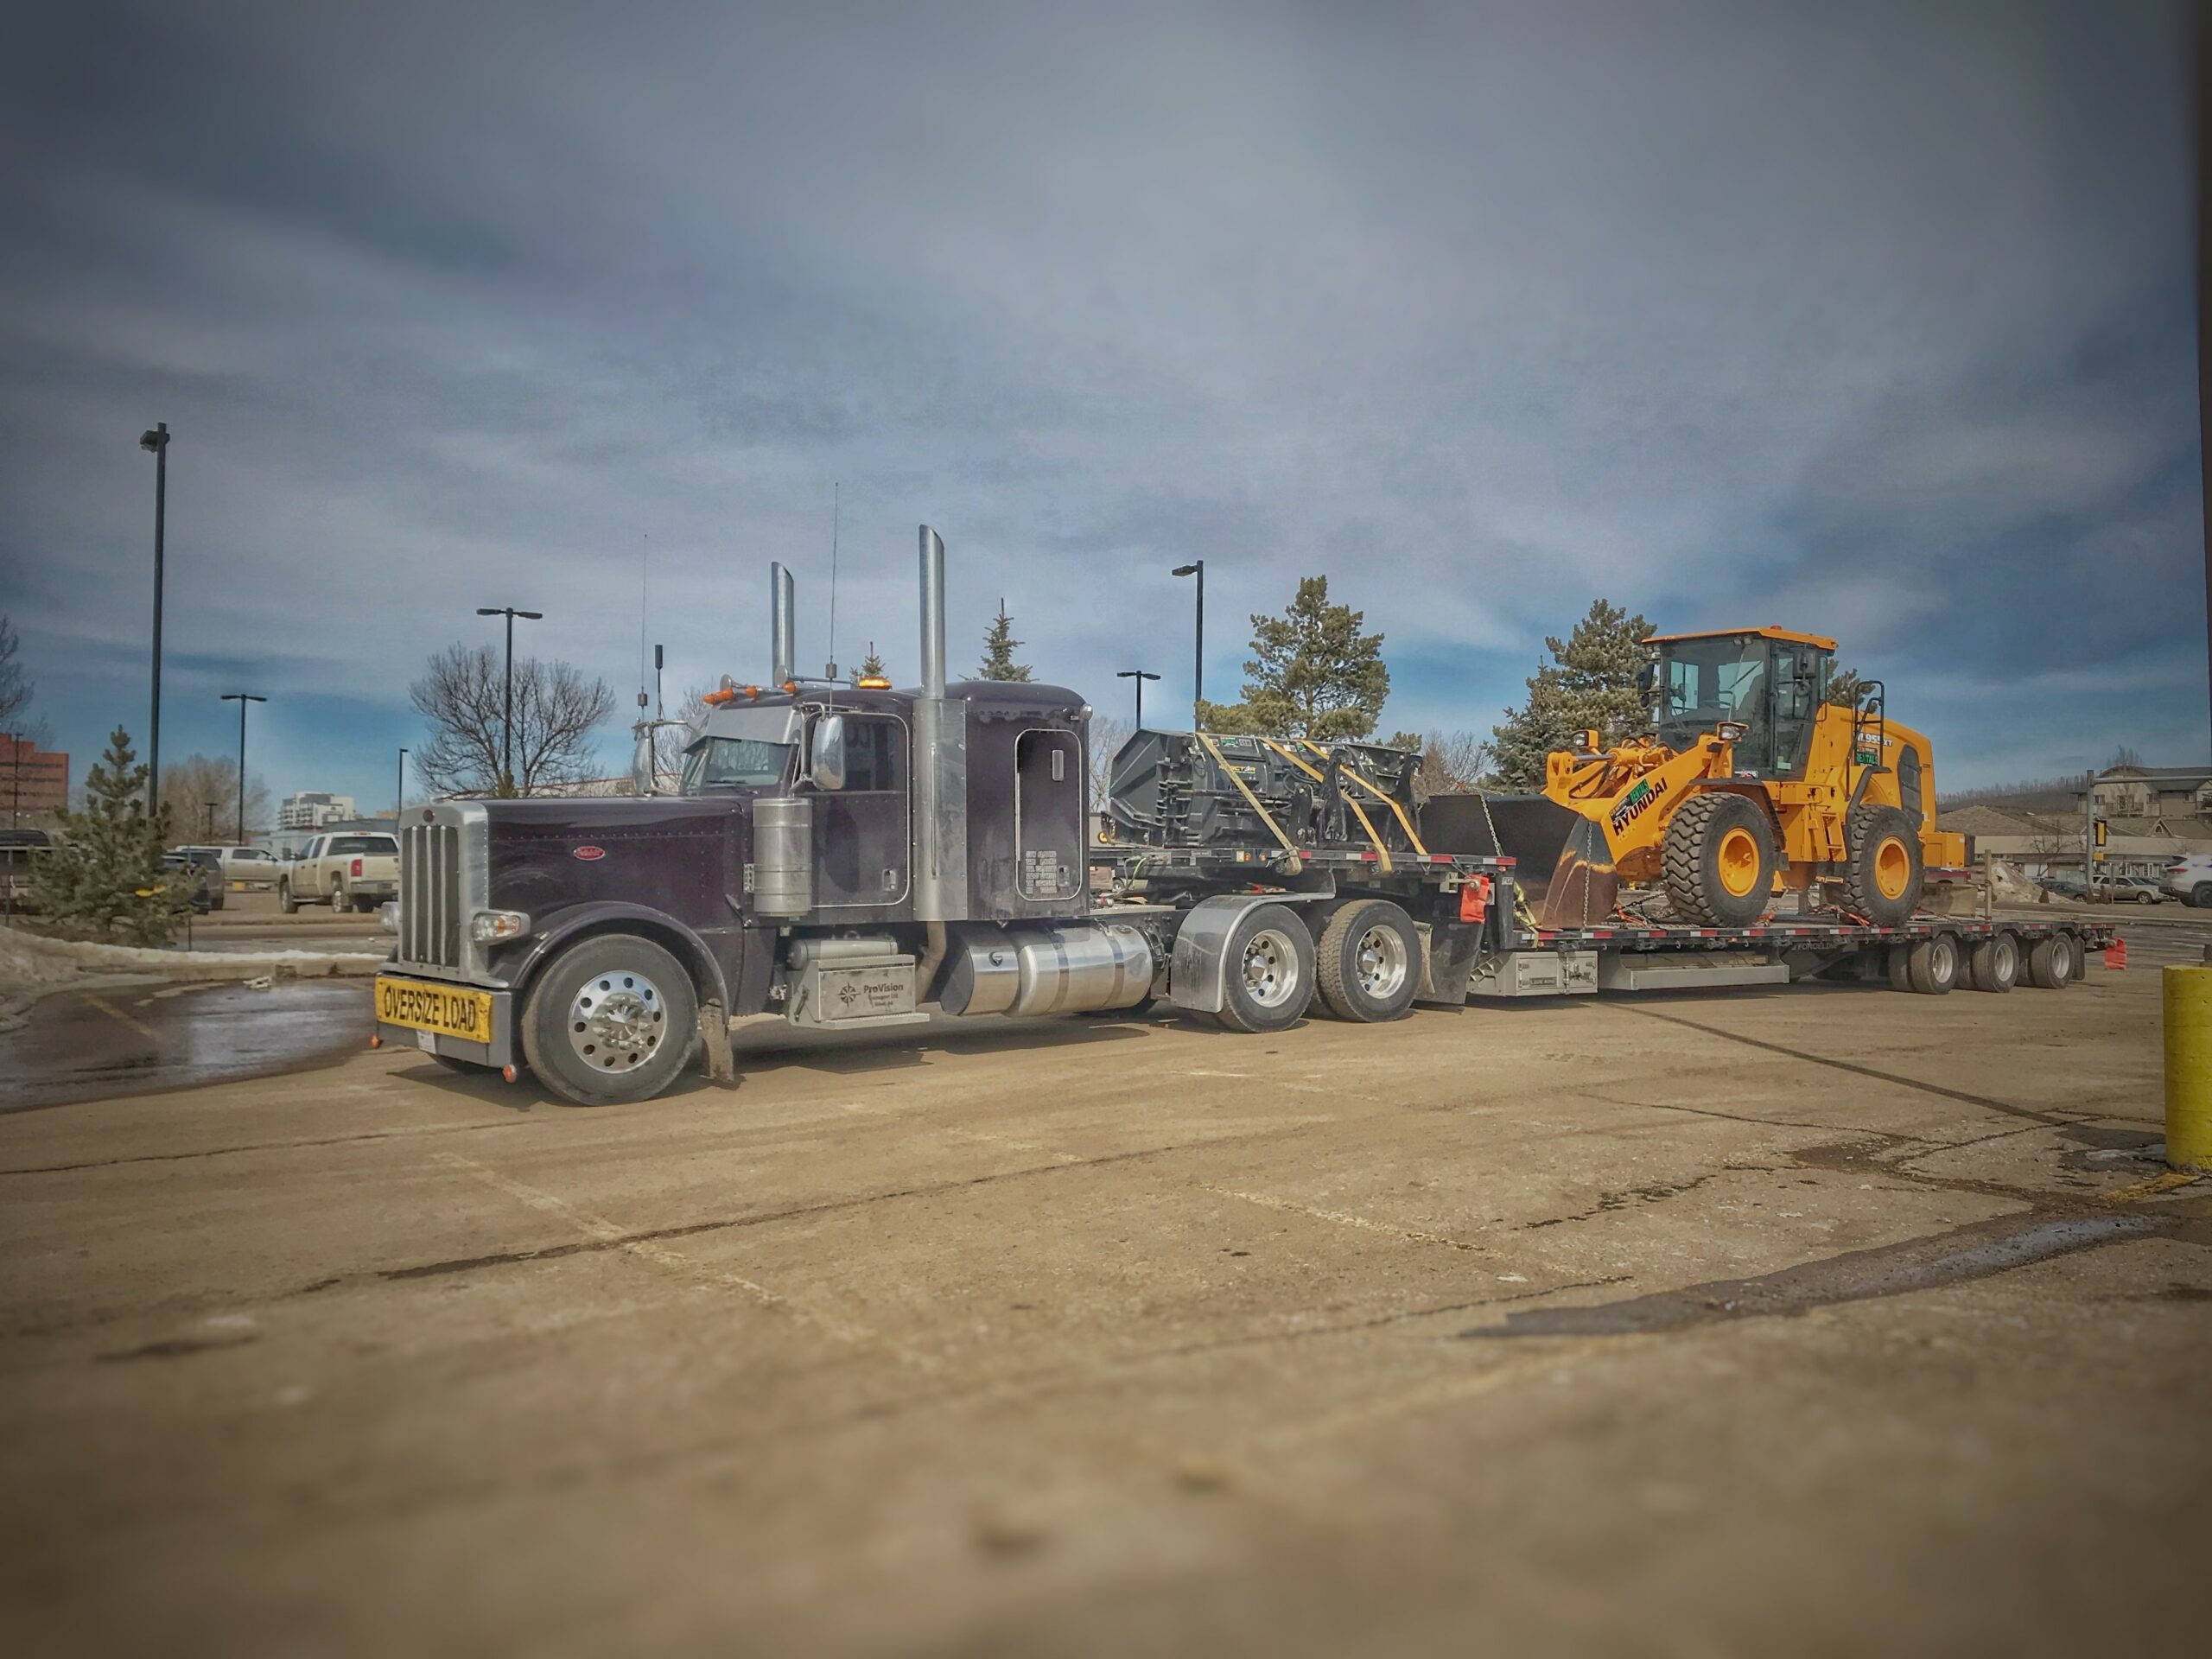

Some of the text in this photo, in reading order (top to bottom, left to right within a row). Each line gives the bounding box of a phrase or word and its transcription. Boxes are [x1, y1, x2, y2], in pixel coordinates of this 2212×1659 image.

[1612, 777, 1668, 837] HYUNDAI
[385, 986, 476, 1033] OVERSIZE LOAD
[863, 982, 904, 994] ProVision
